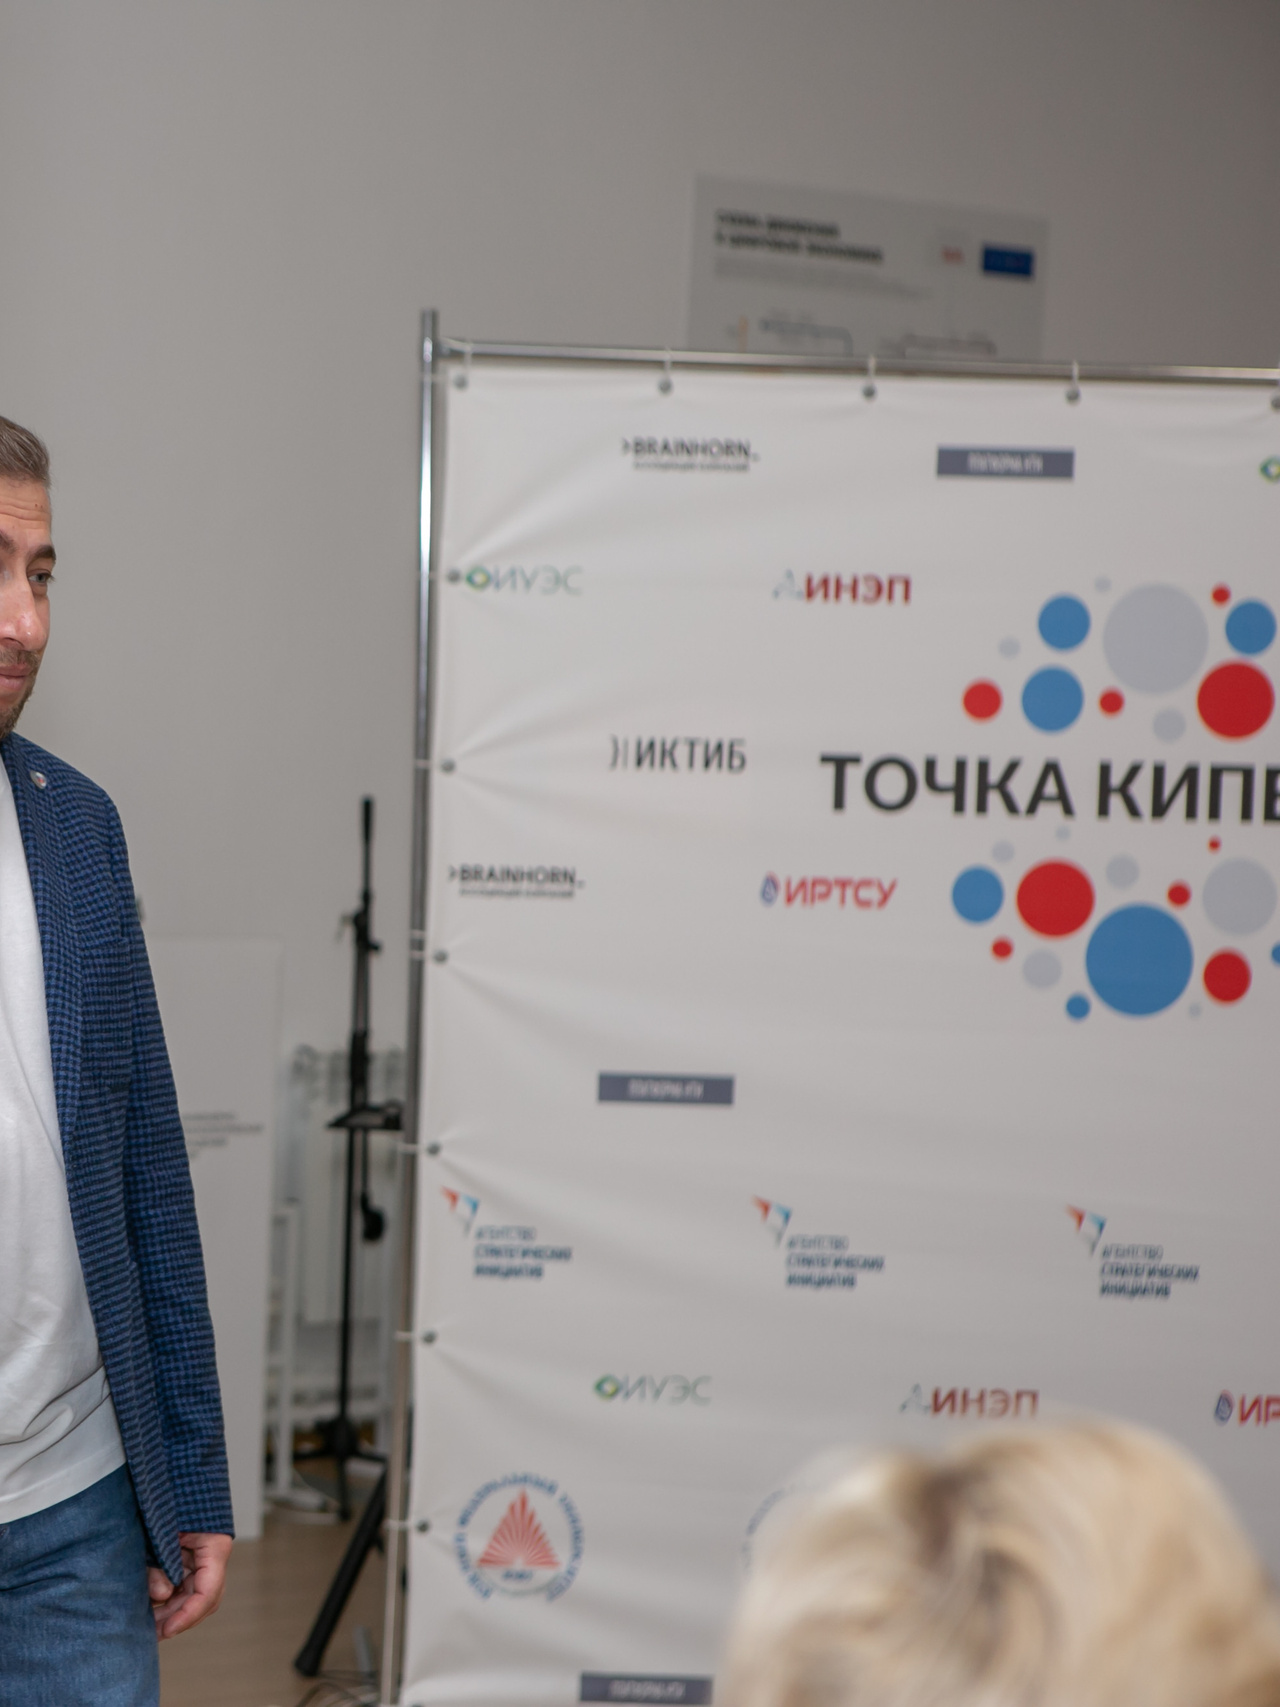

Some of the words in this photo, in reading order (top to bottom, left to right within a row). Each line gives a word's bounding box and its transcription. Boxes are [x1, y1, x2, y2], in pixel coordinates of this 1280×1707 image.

[635, 737, 747, 774] ИКТИБ
[819, 753, 1076, 820] ТОЧКА
[785, 876, 898, 910] ИРТСУ
